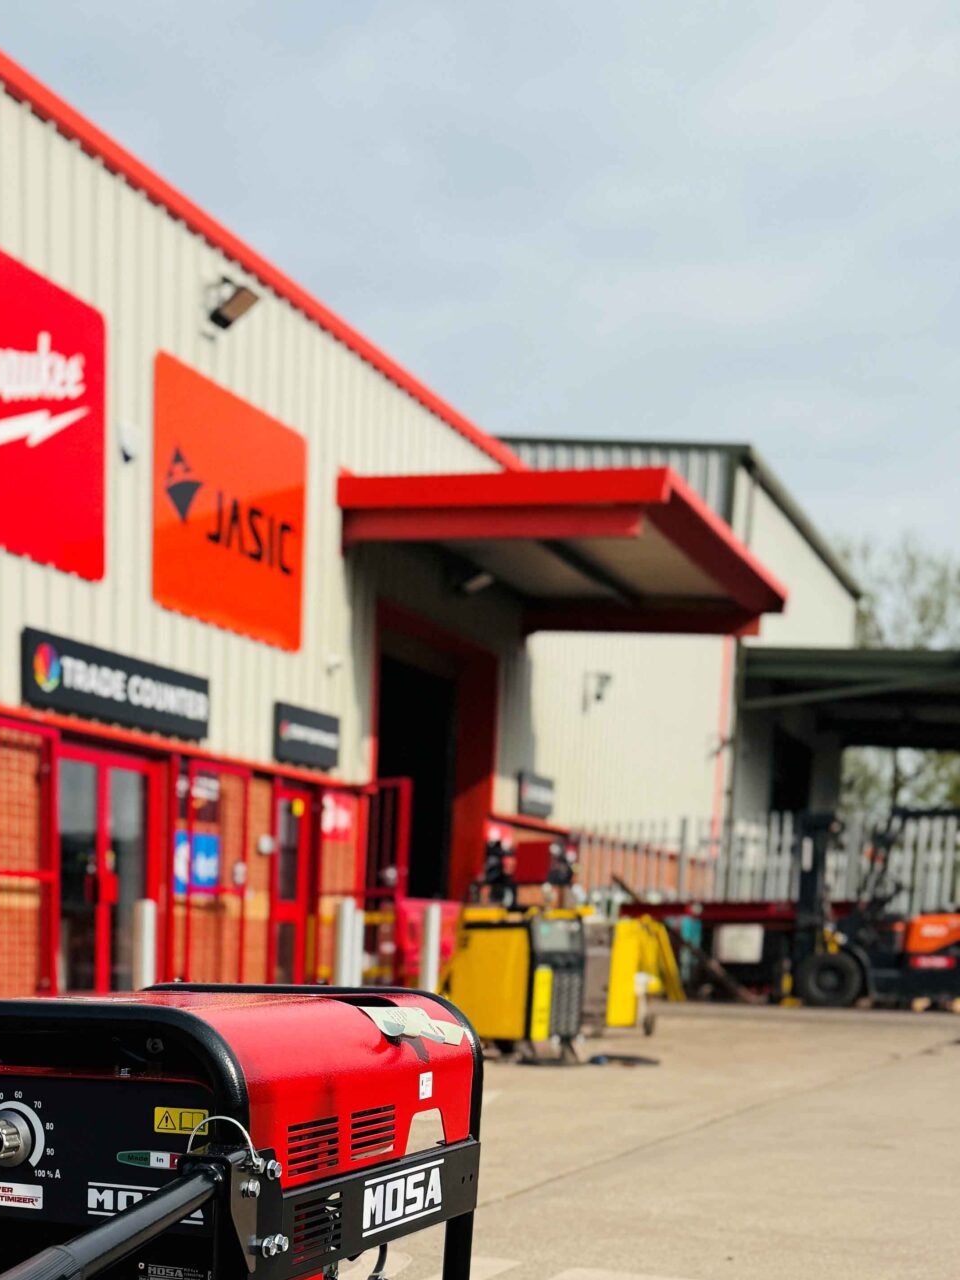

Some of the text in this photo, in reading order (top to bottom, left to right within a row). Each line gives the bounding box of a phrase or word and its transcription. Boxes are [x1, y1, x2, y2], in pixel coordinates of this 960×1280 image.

[206, 491, 293, 576] JASIC
[60, 655, 209, 721] TRADE COUNTER
[14, 1091, 23, 1099] 60
[45, 1122, 54, 1130] 80
[46, 1148, 55, 1156] 90
[156, 1156, 164, 1164] In
[34, 1169, 46, 1177] 100
[54, 1168, 61, 1179] A
[362, 1167, 442, 1230] MOSA
[148, 1266, 184, 1278] MOSA
